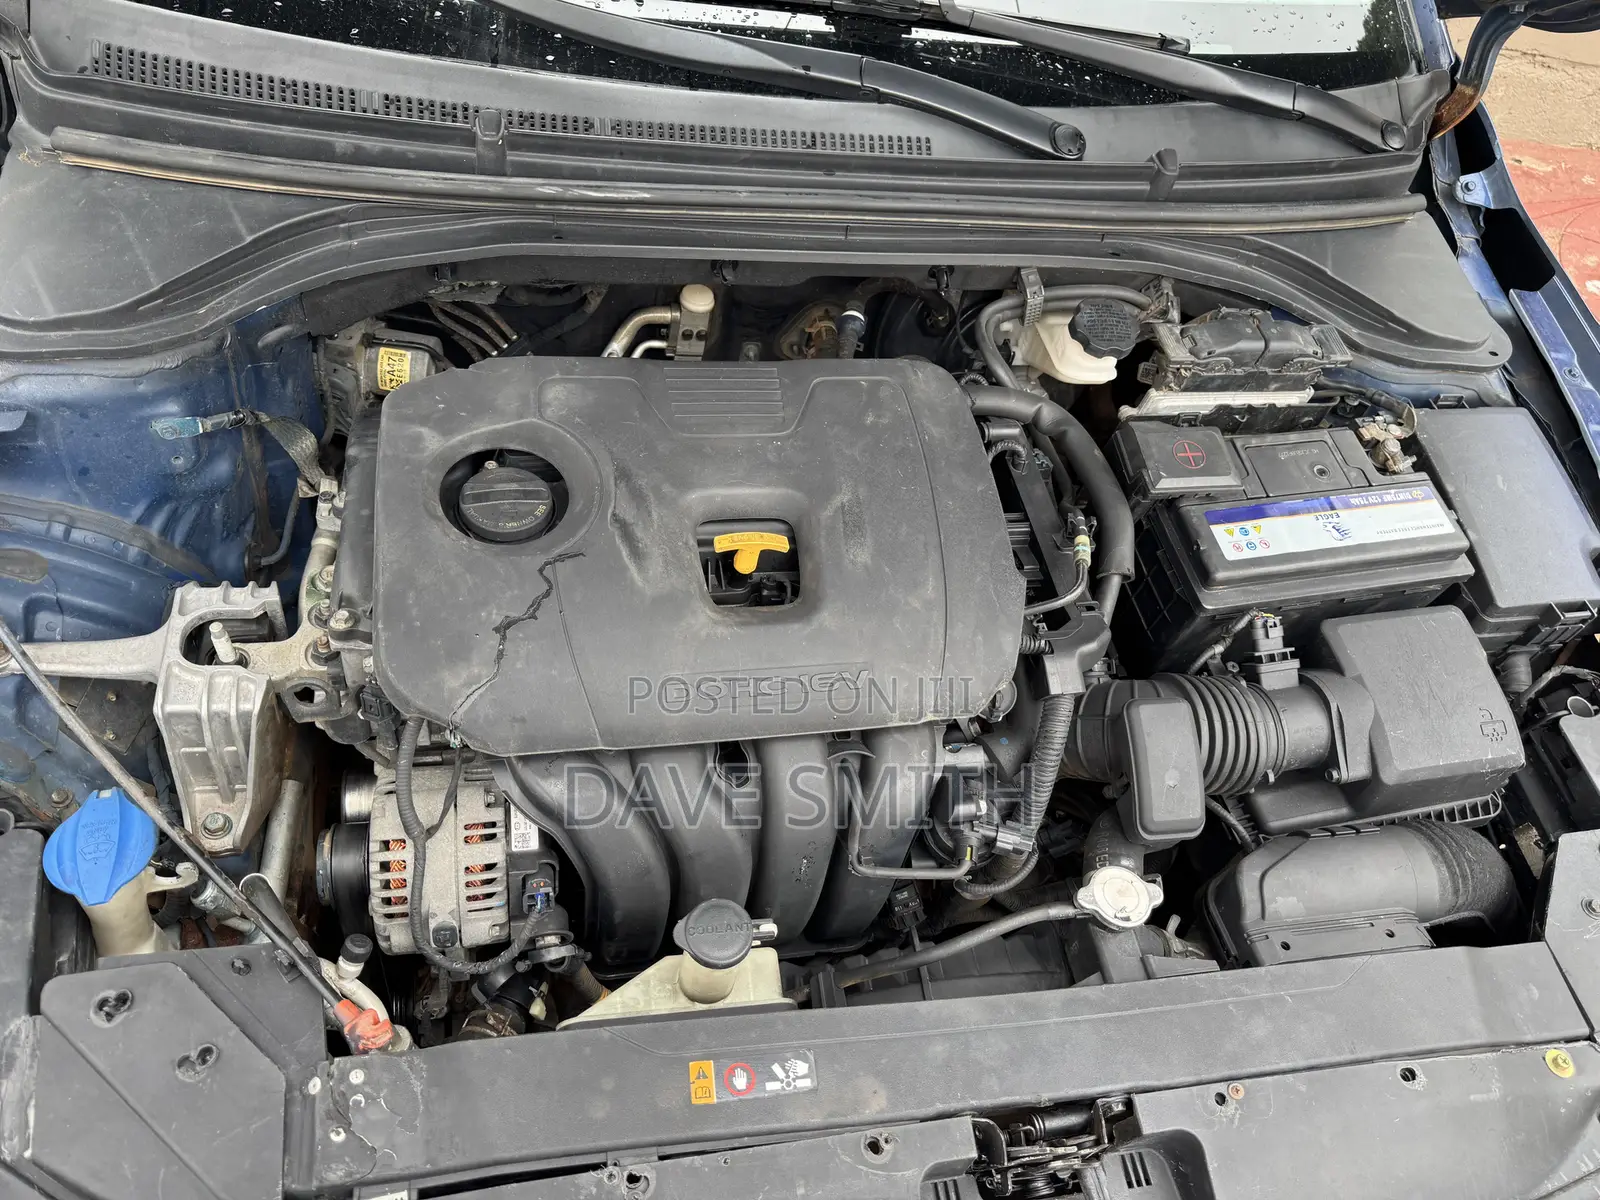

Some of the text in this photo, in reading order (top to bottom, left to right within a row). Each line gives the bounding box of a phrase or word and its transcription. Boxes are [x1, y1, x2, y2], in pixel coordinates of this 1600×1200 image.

[1369, 495, 1381, 504] 12V
[534, 504, 547, 517] SEE
[1313, 511, 1340, 521] EAGLE
[688, 922, 751, 936] COOLANT
